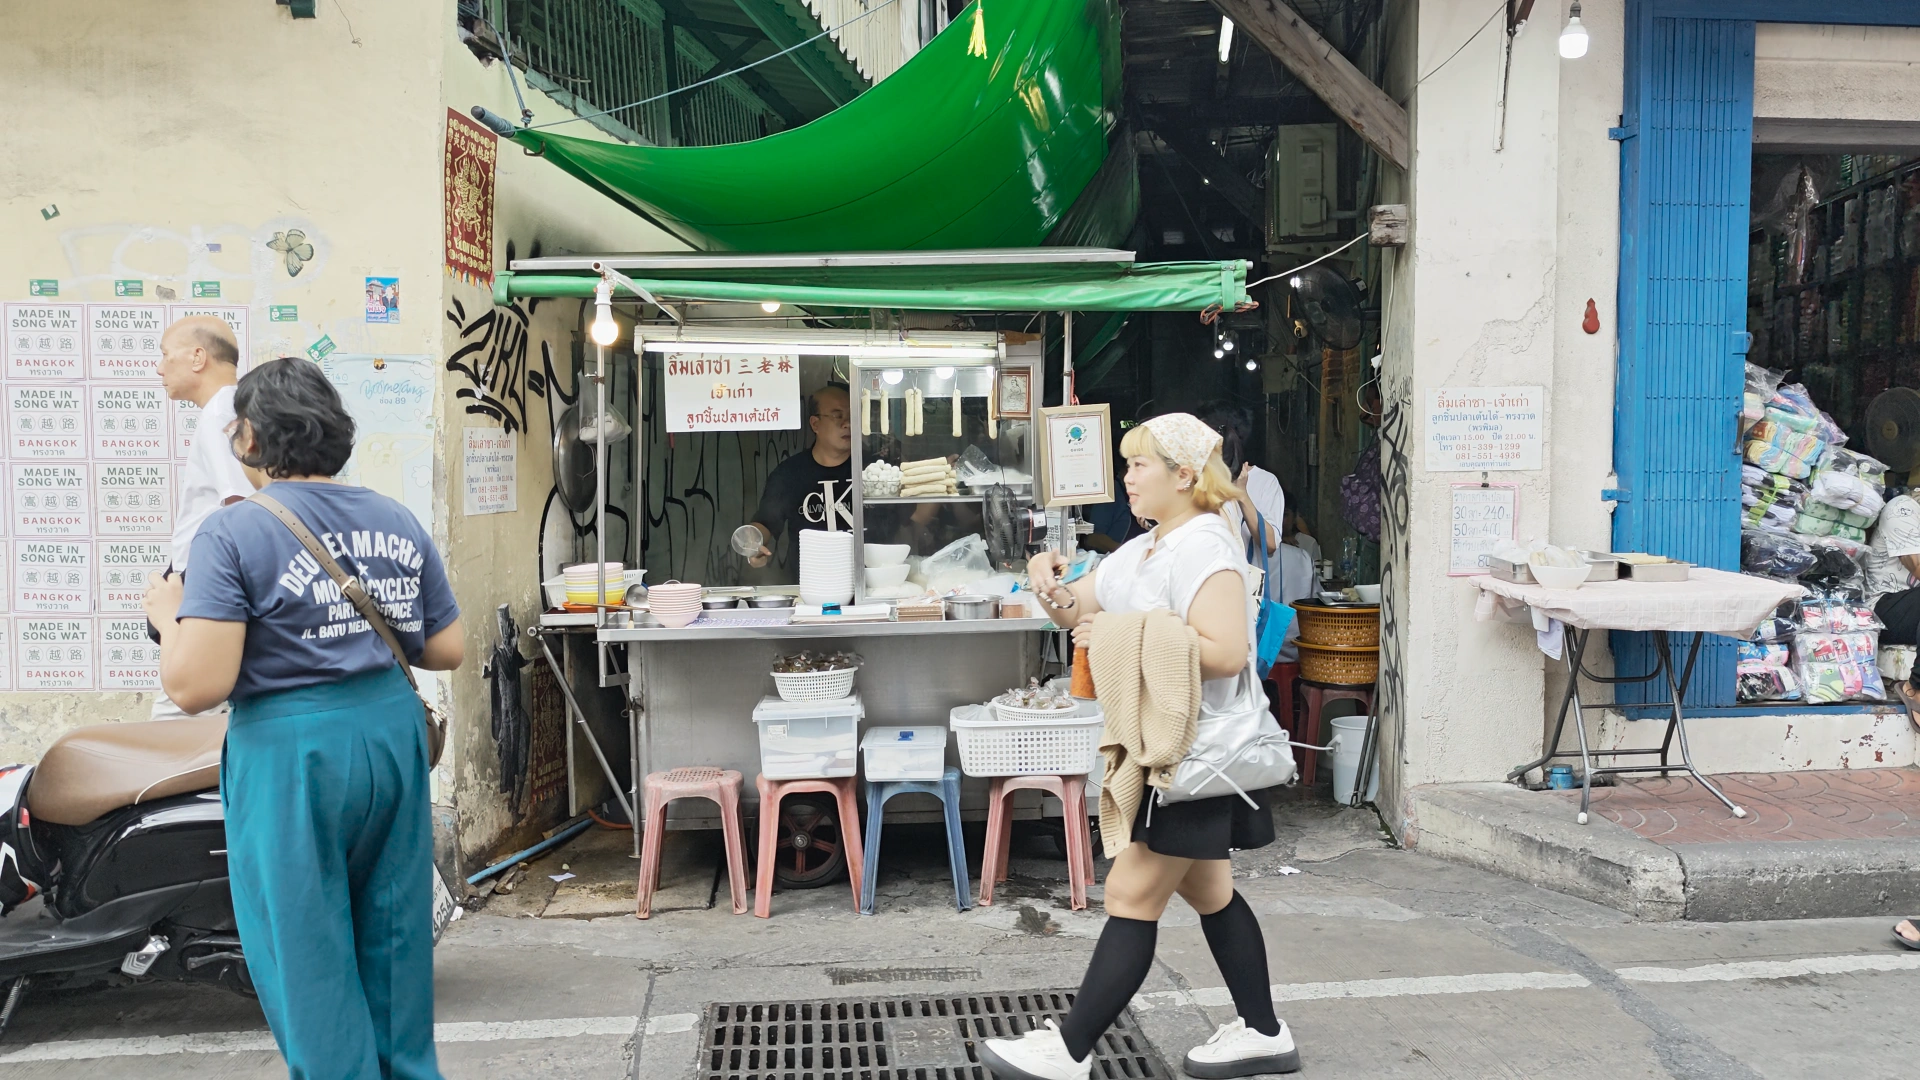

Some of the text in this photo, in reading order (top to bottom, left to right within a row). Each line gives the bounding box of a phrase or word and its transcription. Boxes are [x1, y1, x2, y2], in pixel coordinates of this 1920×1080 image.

[18, 309, 71, 318] MADE IN
[101, 310, 153, 319] MADE IN
[223, 312, 235, 320] IN
[12, 319, 77, 329] SONG WAT
[95, 320, 160, 329] SONG WAT
[16, 359, 75, 367] BANGKOK
[20, 390, 73, 399] MADE IN
[103, 391, 155, 400] MADE IN
[1438, 390, 1529, 408] ลิ้มเล่าซา-เจ้าเก่า
[14, 400, 79, 409] SONG WAT
[97, 400, 162, 410] SONG WAT
[395, 397, 406, 405] 89
[1468, 423, 1503, 432] (พรพิมล)
[1432, 433, 1460, 441] เปิดเวลา
[1438, 442, 1453, 451] โทร
[32, 449, 65, 457] ทรงวาด
[115, 449, 148, 457] ทรงวาด
[1456, 452, 1520, 460] 081-551-4936
[1460, 460, 1511, 469] อบคุณทุกท่านค่ะ
[24, 468, 76, 477] MADE IN
[107, 467, 158, 476] MADE IN
[18, 477, 82, 487] SONG WAT
[101, 477, 165, 486] SONG WAT
[23, 517, 82, 525] BANGKOK
[106, 515, 164, 523] BANGKOK
[36, 526, 69, 534] ทรงวาด
[27, 544, 79, 554] MADE IN
[110, 545, 161, 554] MADE IN
[21, 554, 85, 564] SONG WAT
[104, 554, 167, 563] SONG WAT
[279, 549, 320, 598] DEU
[321, 532, 351, 560] EX
[109, 572, 142, 584] 嵩越
[23, 593, 82, 602] BANGKOK
[28, 622, 80, 631] MADE IN
[112, 622, 147, 631] MADE
[22, 631, 87, 641] SONG WAT
[301, 629, 316, 639] JL.
[319, 624, 346, 638] BATU
[105, 632, 140, 641] SONG
[27, 670, 85, 678] BANGKOK
[109, 670, 158, 678] BANGKO
